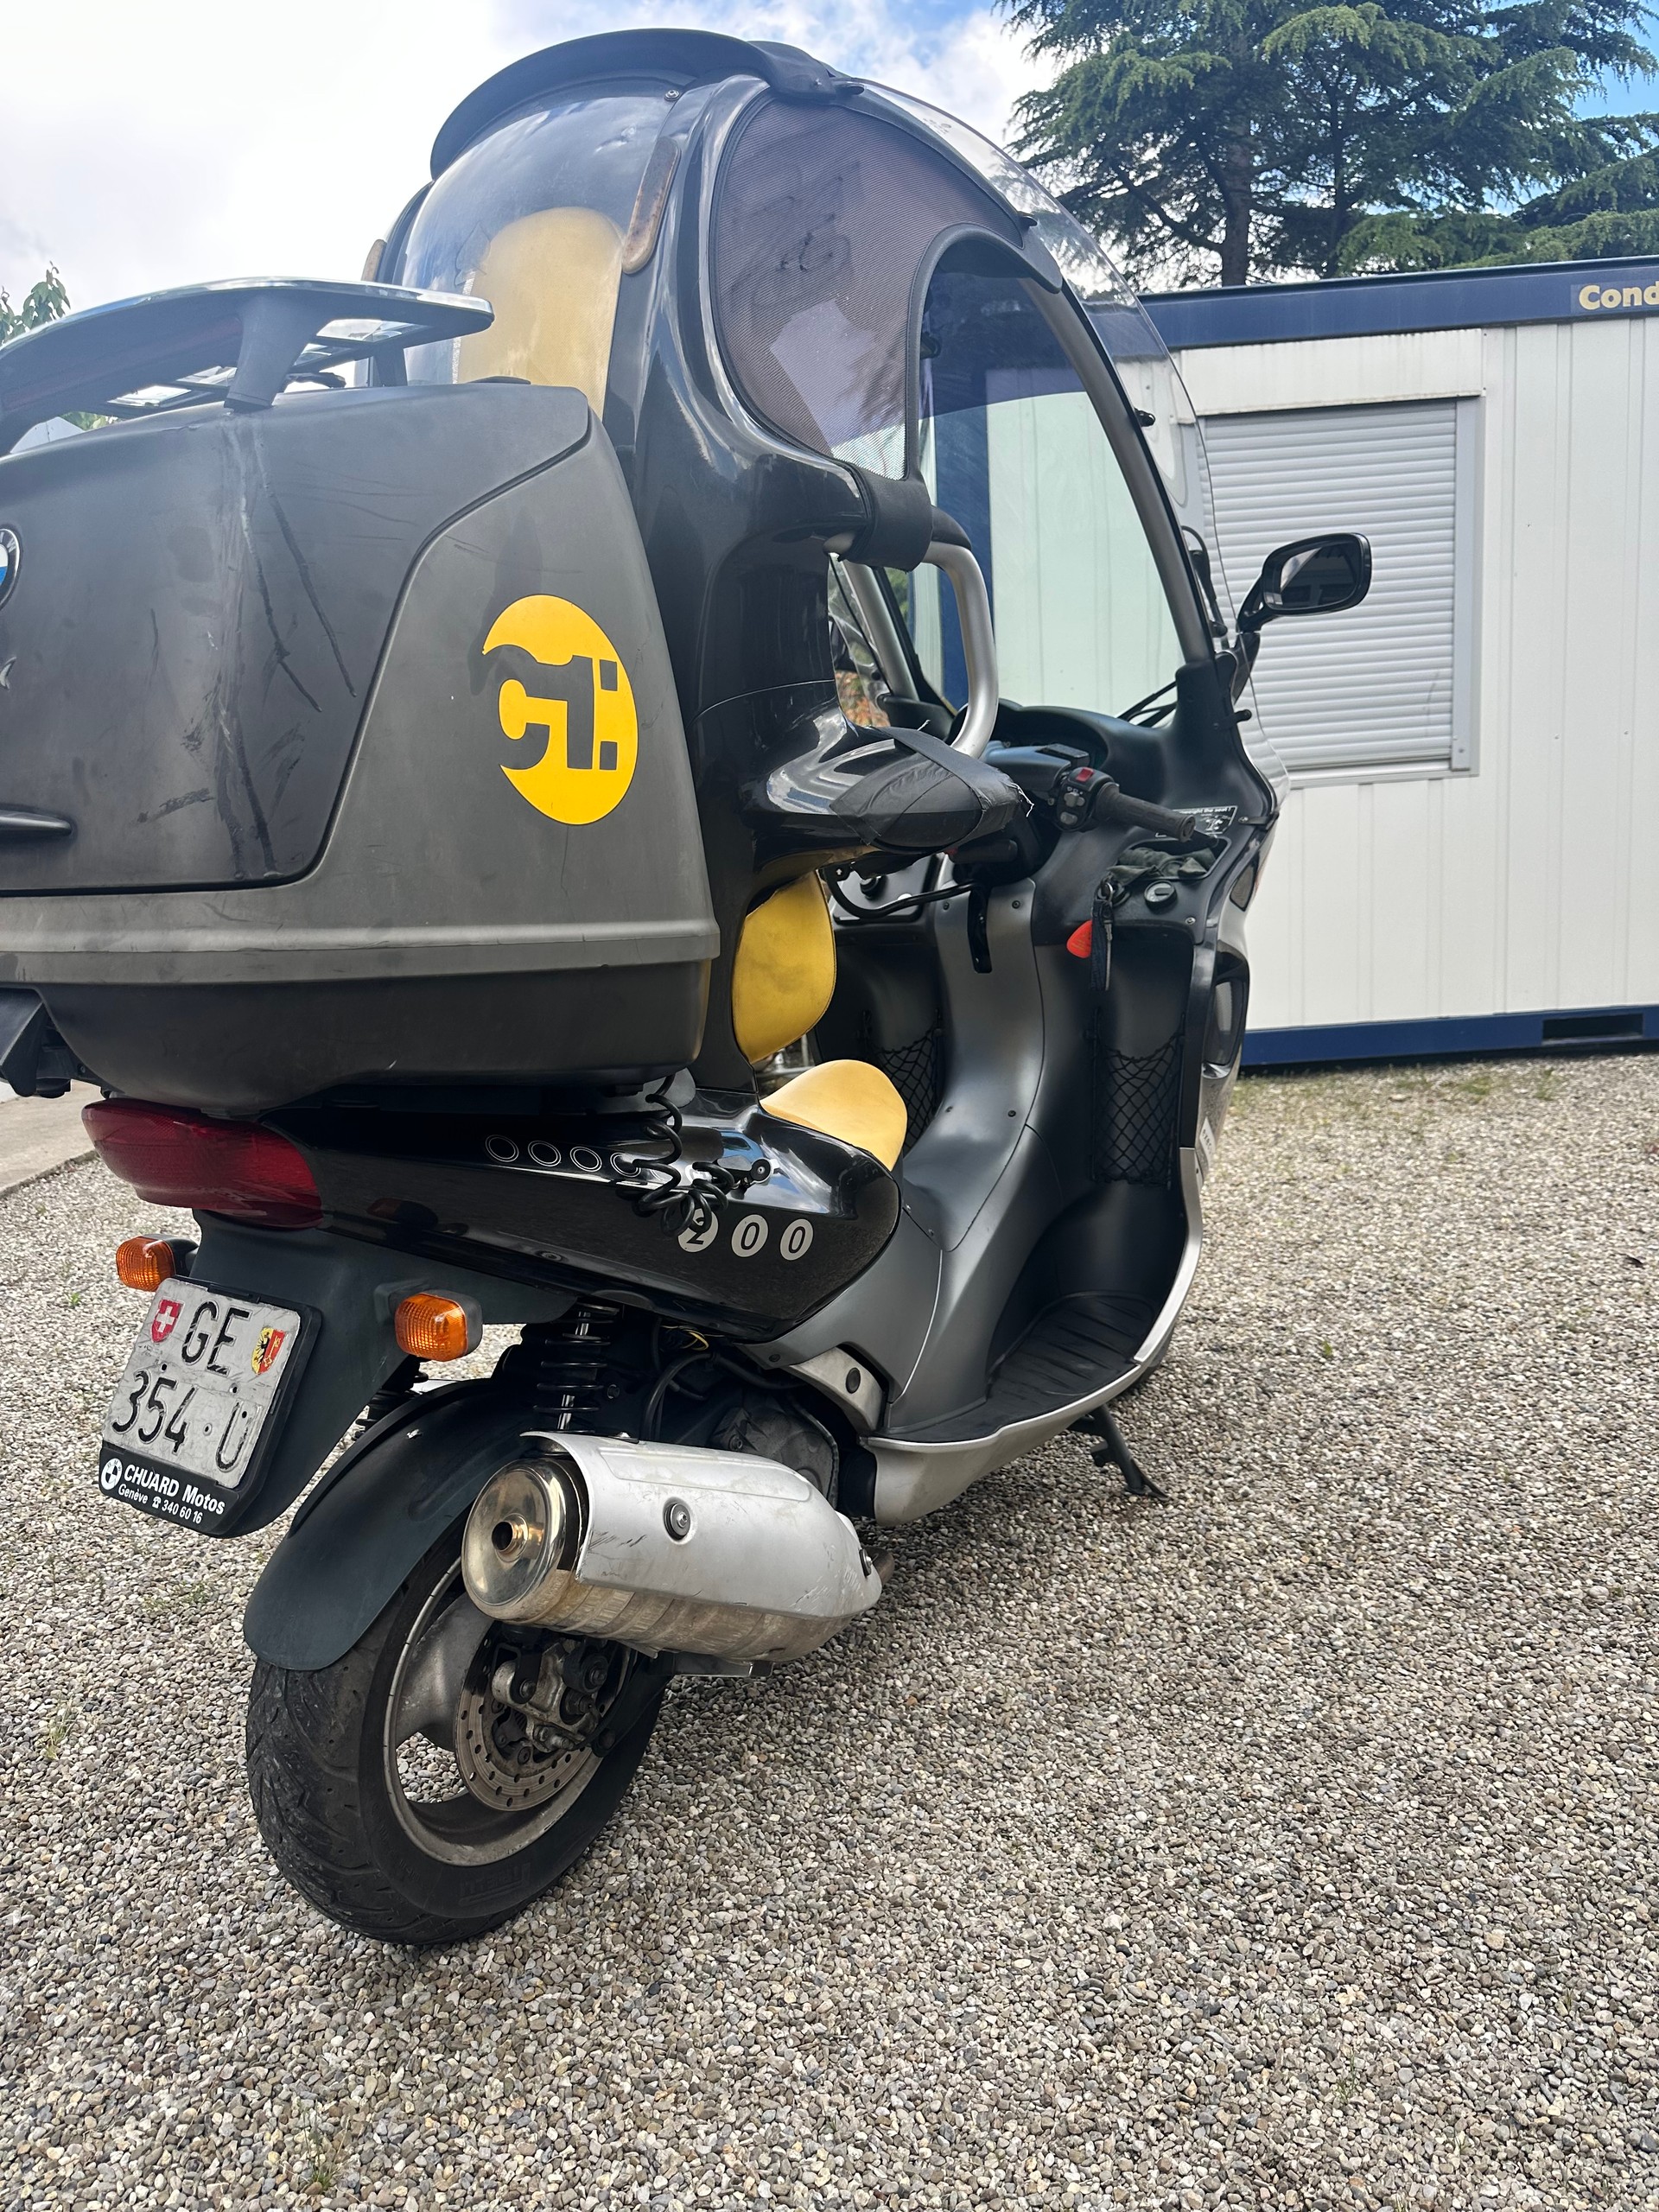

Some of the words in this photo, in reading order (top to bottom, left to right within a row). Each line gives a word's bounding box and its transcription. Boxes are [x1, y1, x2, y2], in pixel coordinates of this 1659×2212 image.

[1579, 281, 1659, 310] Cond
[181, 1301, 251, 1375] GE
[111, 1370, 197, 1454] 354
[118, 1483, 149, 1504] Genève
[162, 1498, 179, 1516] 340
[179, 1504, 192, 1520] 60
[193, 1510, 203, 1524] 16
[124, 1464, 180, 1497] CHUARD
[181, 1484, 226, 1515] Motos
